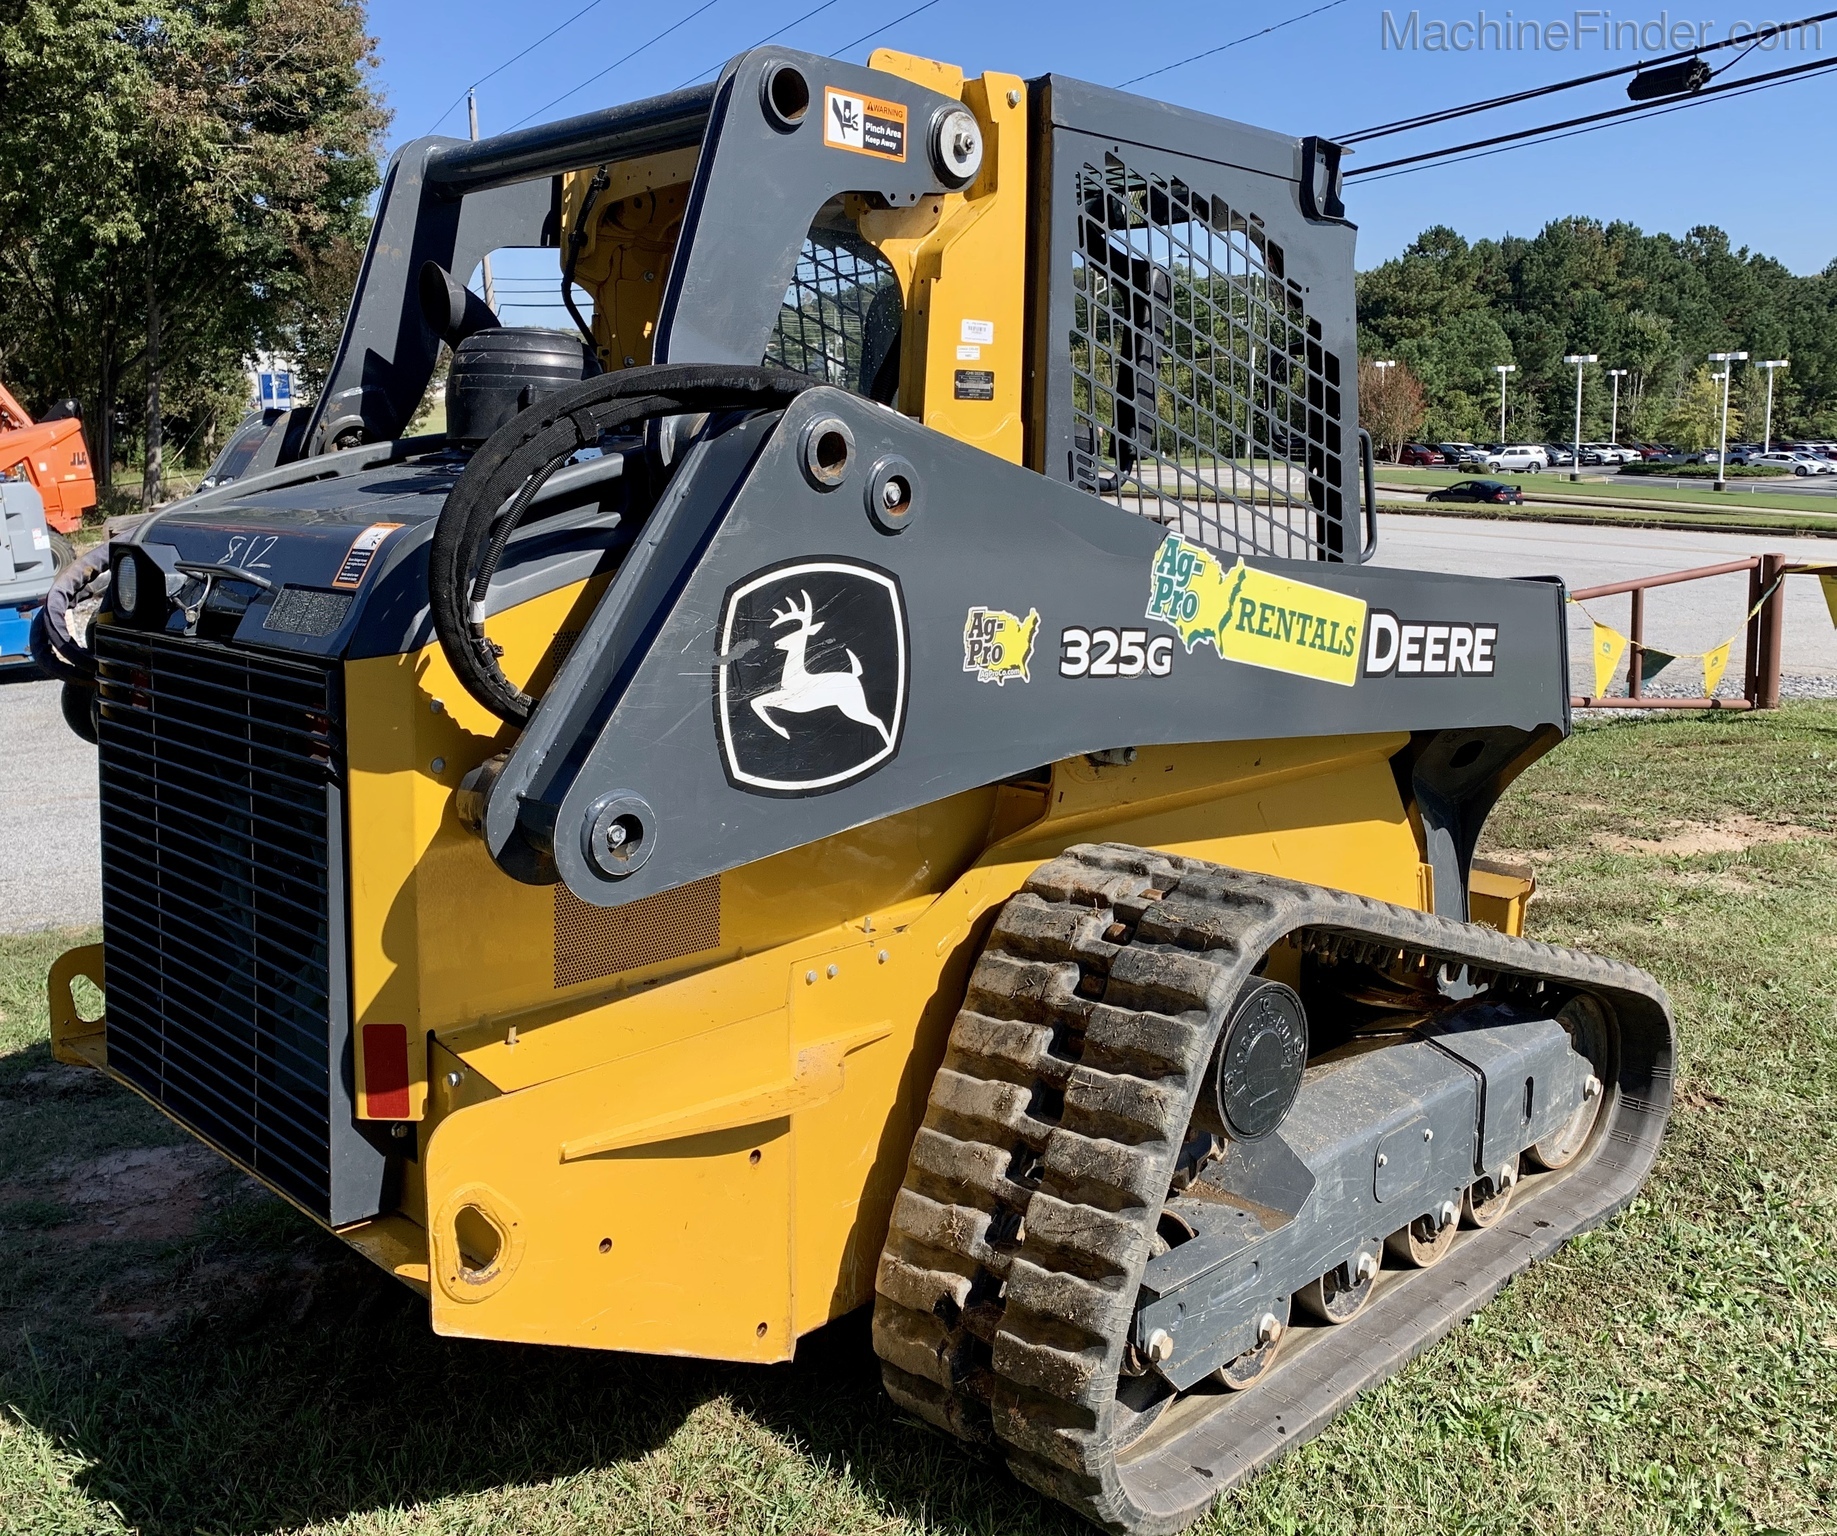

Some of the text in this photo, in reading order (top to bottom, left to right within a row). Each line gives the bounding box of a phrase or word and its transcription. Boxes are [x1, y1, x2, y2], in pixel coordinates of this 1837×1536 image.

[873, 104, 904, 119] WARNING
[865, 122, 902, 139] Pinch Area
[865, 134, 897, 150] Keep Away
[217, 535, 279, 569] 812
[1156, 538, 1205, 587] Ag-
[1150, 577, 1198, 619] Pro
[967, 612, 1004, 644] Ag-
[1235, 597, 1357, 657] RENTALS
[1365, 611, 1498, 674] DEERE
[967, 639, 1004, 667] Pro
[1060, 627, 1173, 677] 325G
[979, 668, 1021, 679] AgProCo.com
